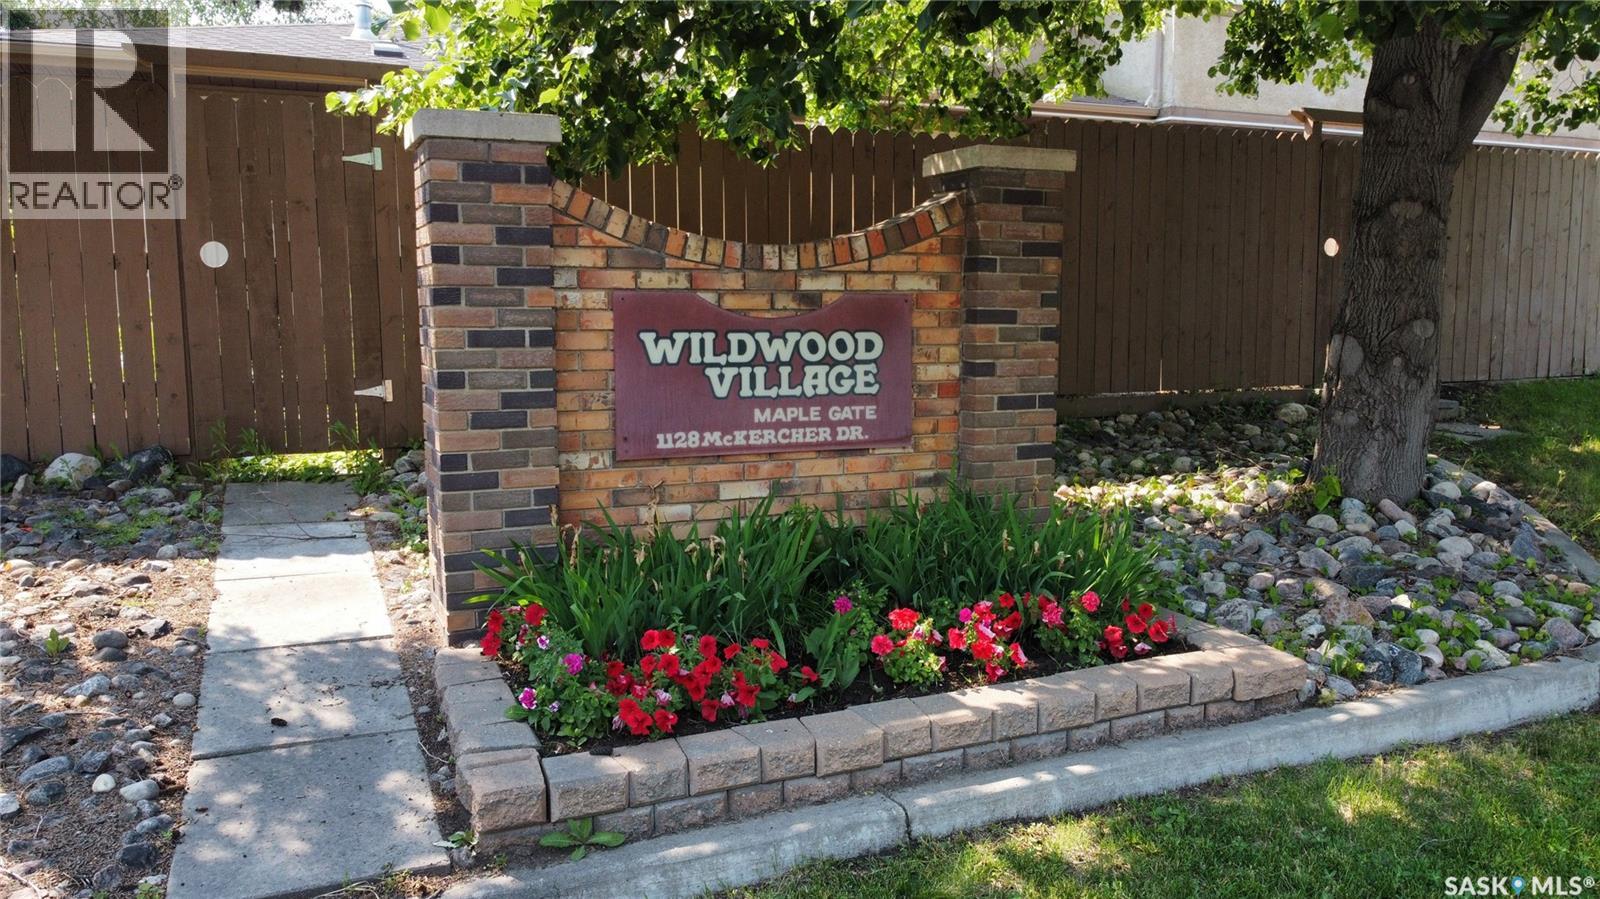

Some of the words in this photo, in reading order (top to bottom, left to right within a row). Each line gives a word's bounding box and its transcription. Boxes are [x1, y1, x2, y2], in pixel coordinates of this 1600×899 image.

[638, 329, 885, 366] WILDWOOD
[704, 364, 881, 399] VILLAGE
[753, 406, 821, 423] MAPLE
[828, 405, 877, 421] GATE
[656, 430, 700, 449] 1128
[703, 427, 832, 447] McKERCHER
[836, 426, 869, 441] DR.
